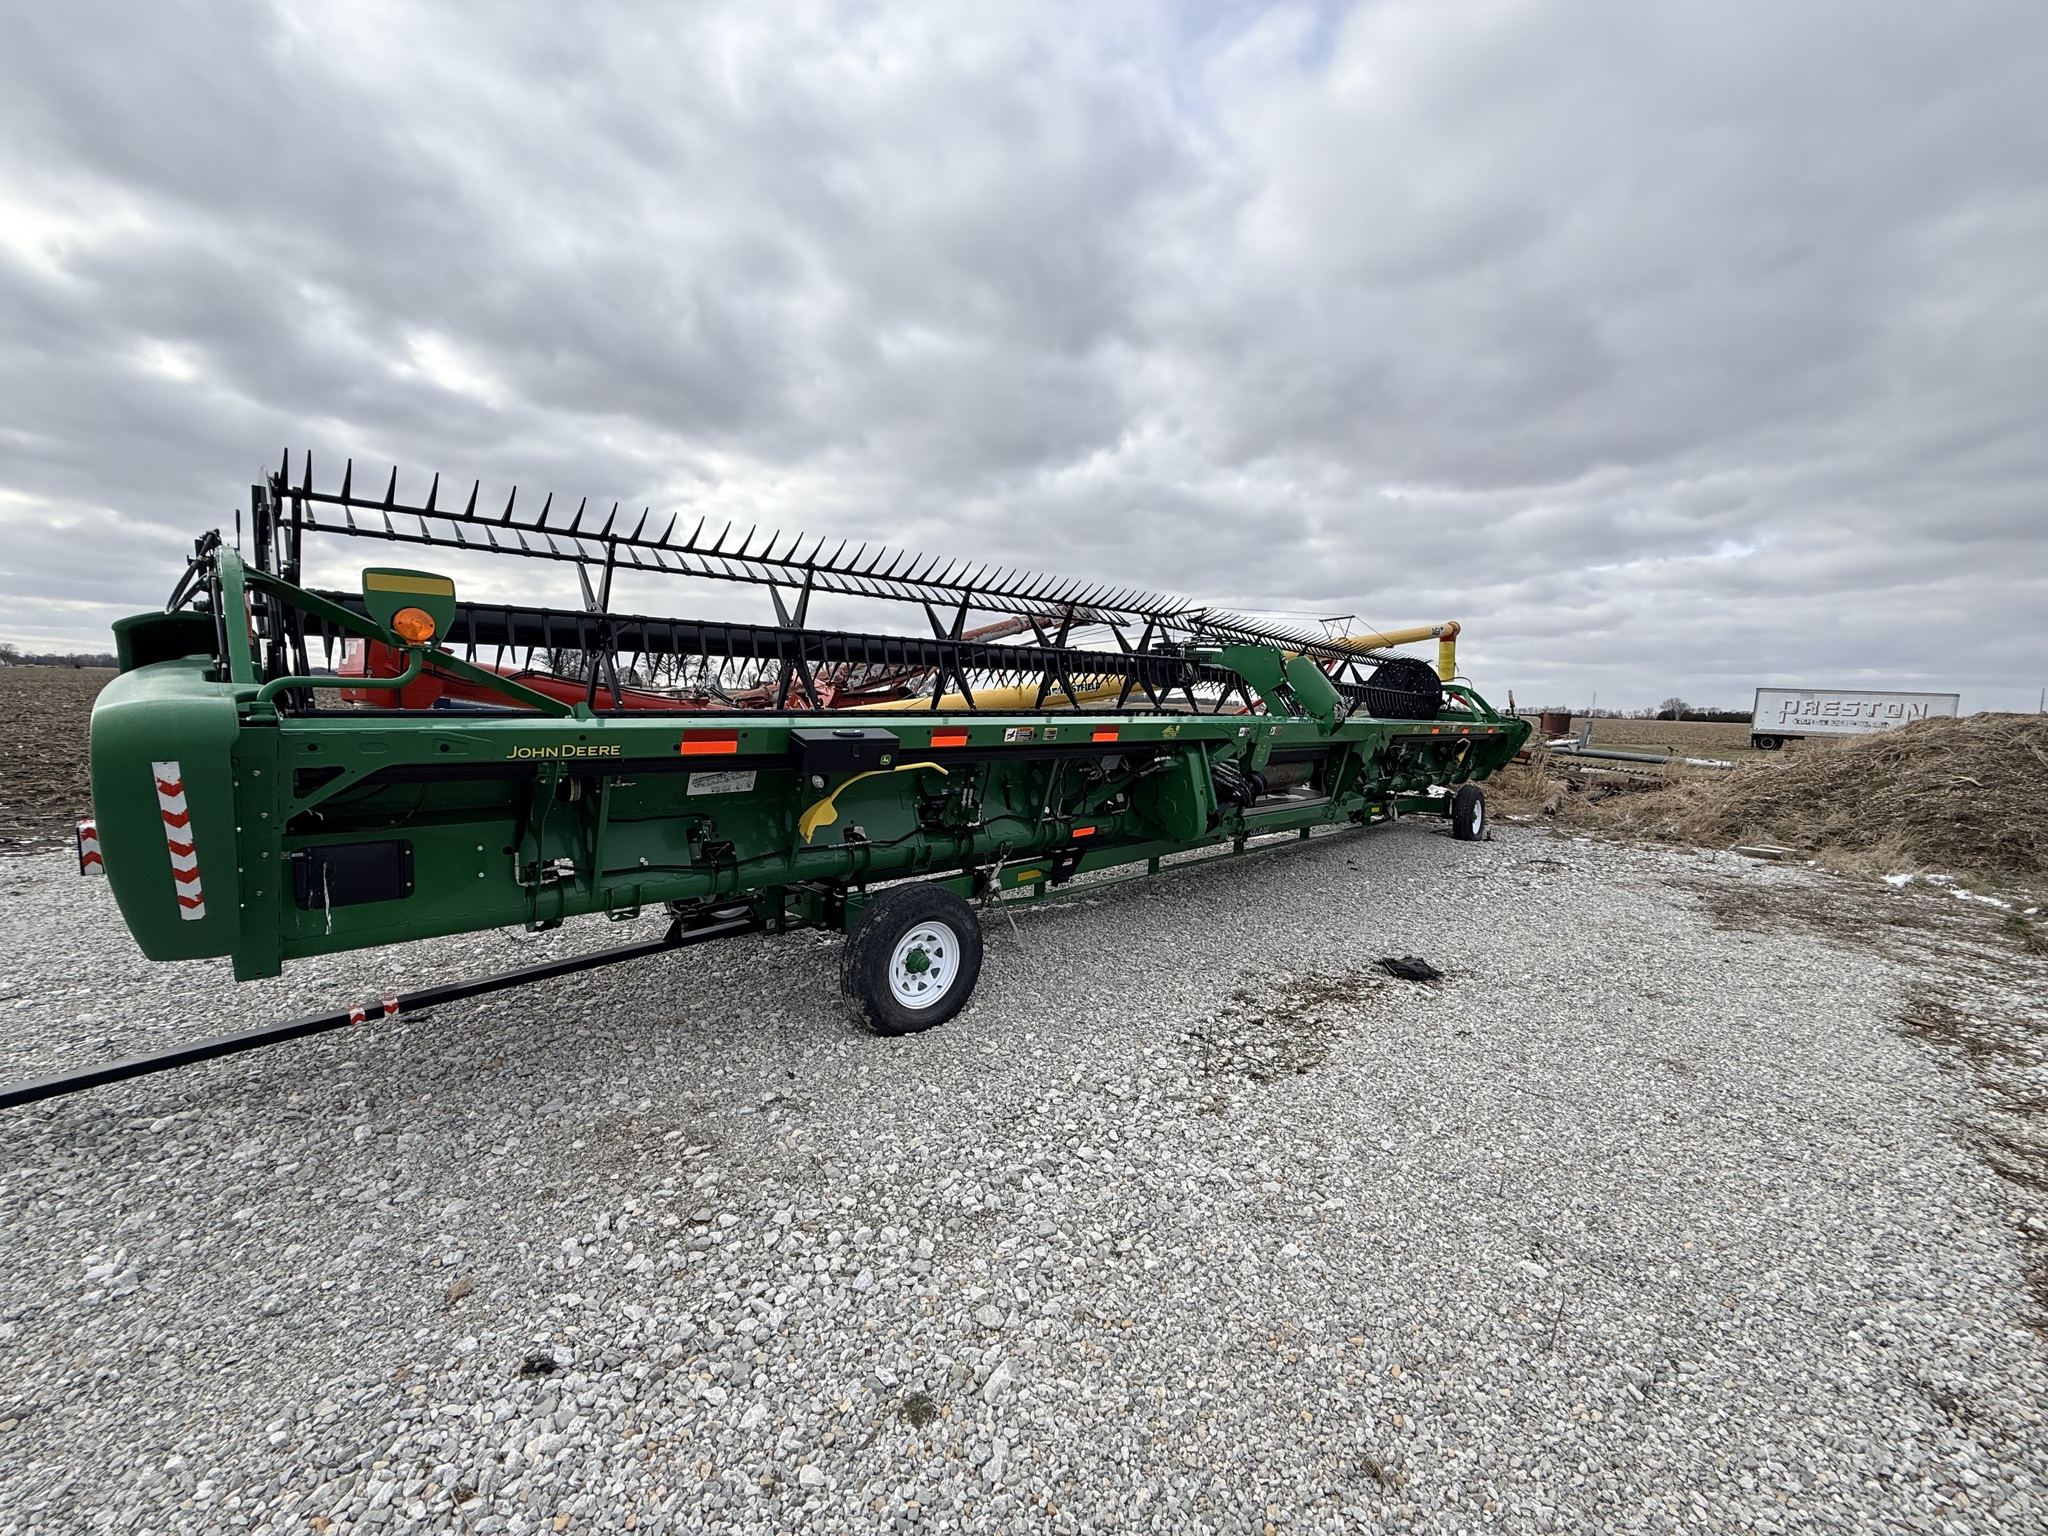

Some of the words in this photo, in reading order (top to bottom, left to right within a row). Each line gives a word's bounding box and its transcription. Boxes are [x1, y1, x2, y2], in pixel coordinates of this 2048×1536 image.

[1778, 699, 1929, 724] PRESTON
[505, 745, 559, 759] JOHN
[561, 744, 621, 758] DEERE
